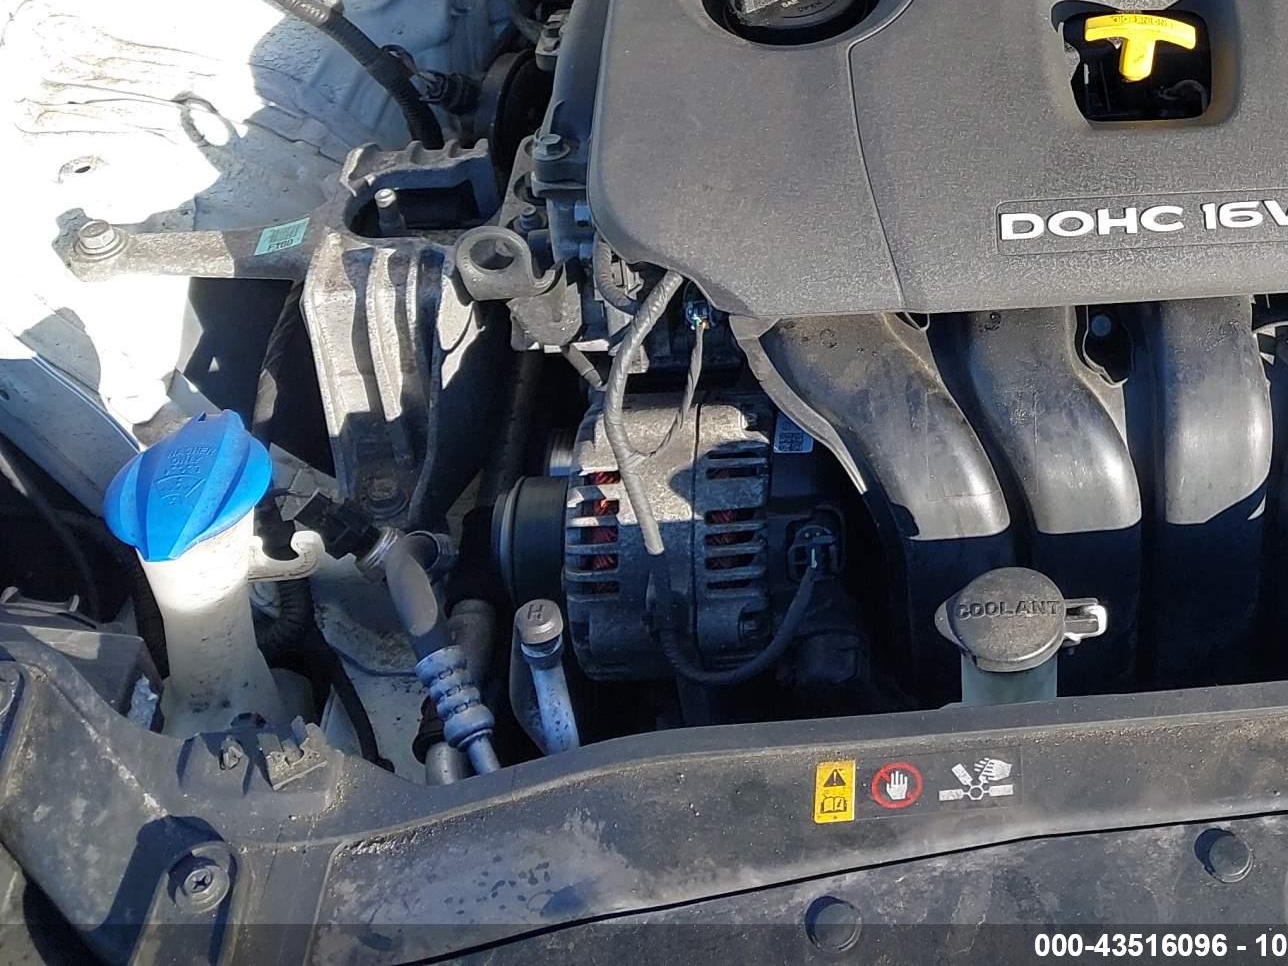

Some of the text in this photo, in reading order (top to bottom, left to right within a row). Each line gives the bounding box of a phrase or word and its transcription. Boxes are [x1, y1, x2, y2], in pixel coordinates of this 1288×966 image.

[1000, 205, 1185, 241] DOHC
[527, 603, 544, 621] H
[958, 600, 1059, 619] COOLANT
